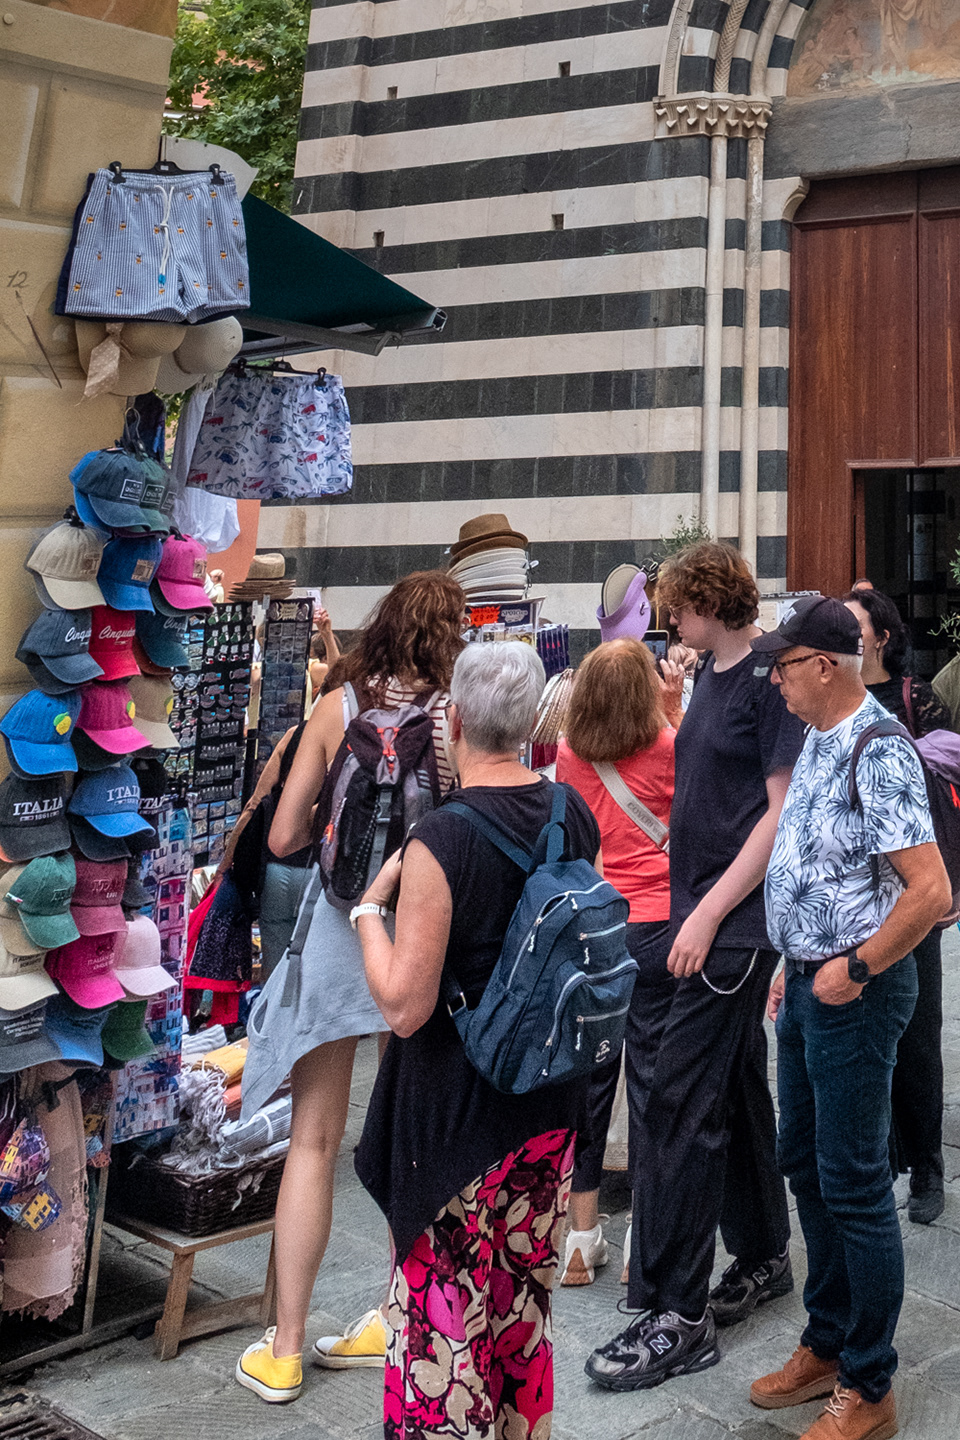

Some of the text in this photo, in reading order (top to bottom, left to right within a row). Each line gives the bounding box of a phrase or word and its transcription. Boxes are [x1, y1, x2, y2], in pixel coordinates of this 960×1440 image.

[7, 270, 30, 288] 12
[12, 796, 64, 816] ITALIA
[626, 801, 655, 828] COVERI
